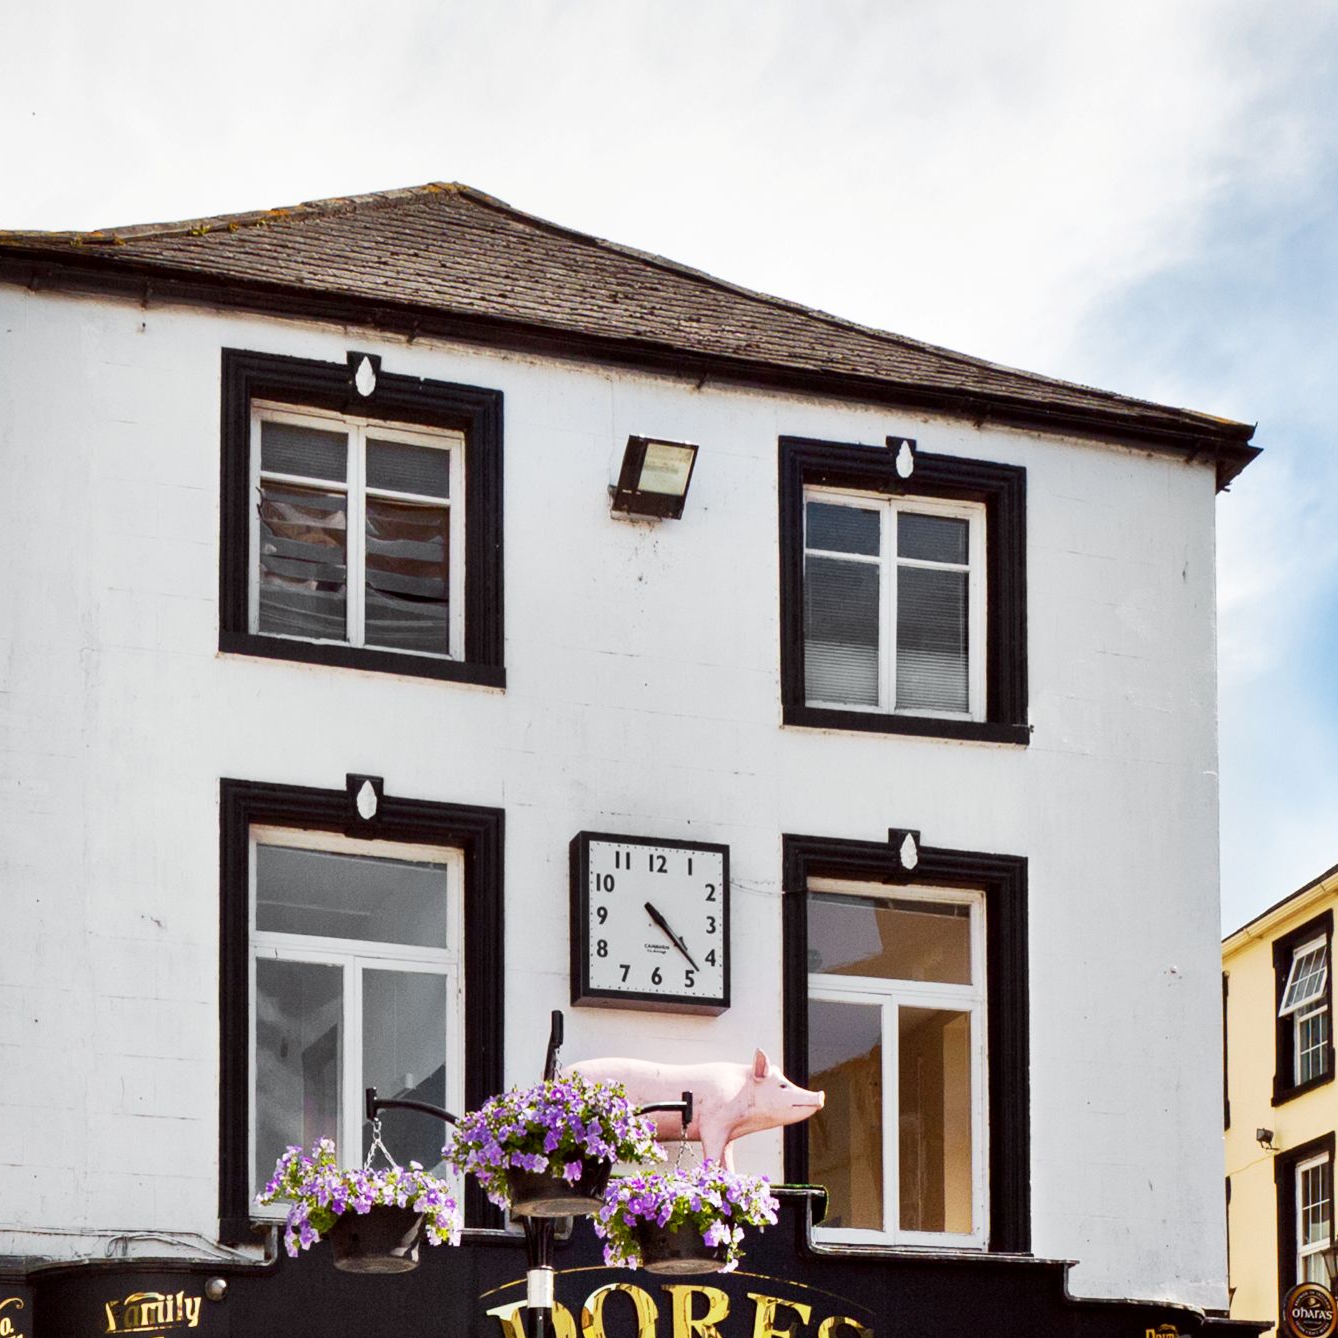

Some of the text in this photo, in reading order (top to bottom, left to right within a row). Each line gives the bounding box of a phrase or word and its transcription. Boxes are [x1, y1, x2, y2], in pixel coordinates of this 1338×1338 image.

[615, 850, 631, 870] 11
[649, 854, 668, 874] 12
[687, 858, 693, 876] 1
[595, 872, 615, 892] 10
[705, 884, 716, 902] 2
[597, 906, 608, 924] 9
[705, 916, 717, 934] 3
[597, 940, 608, 958] 8
[705, 950, 717, 968] 4
[619, 964, 631, 982] 7
[651, 966, 663, 985] 6
[684, 970, 695, 988] 5
[104, 1290, 202, 1333] Family
